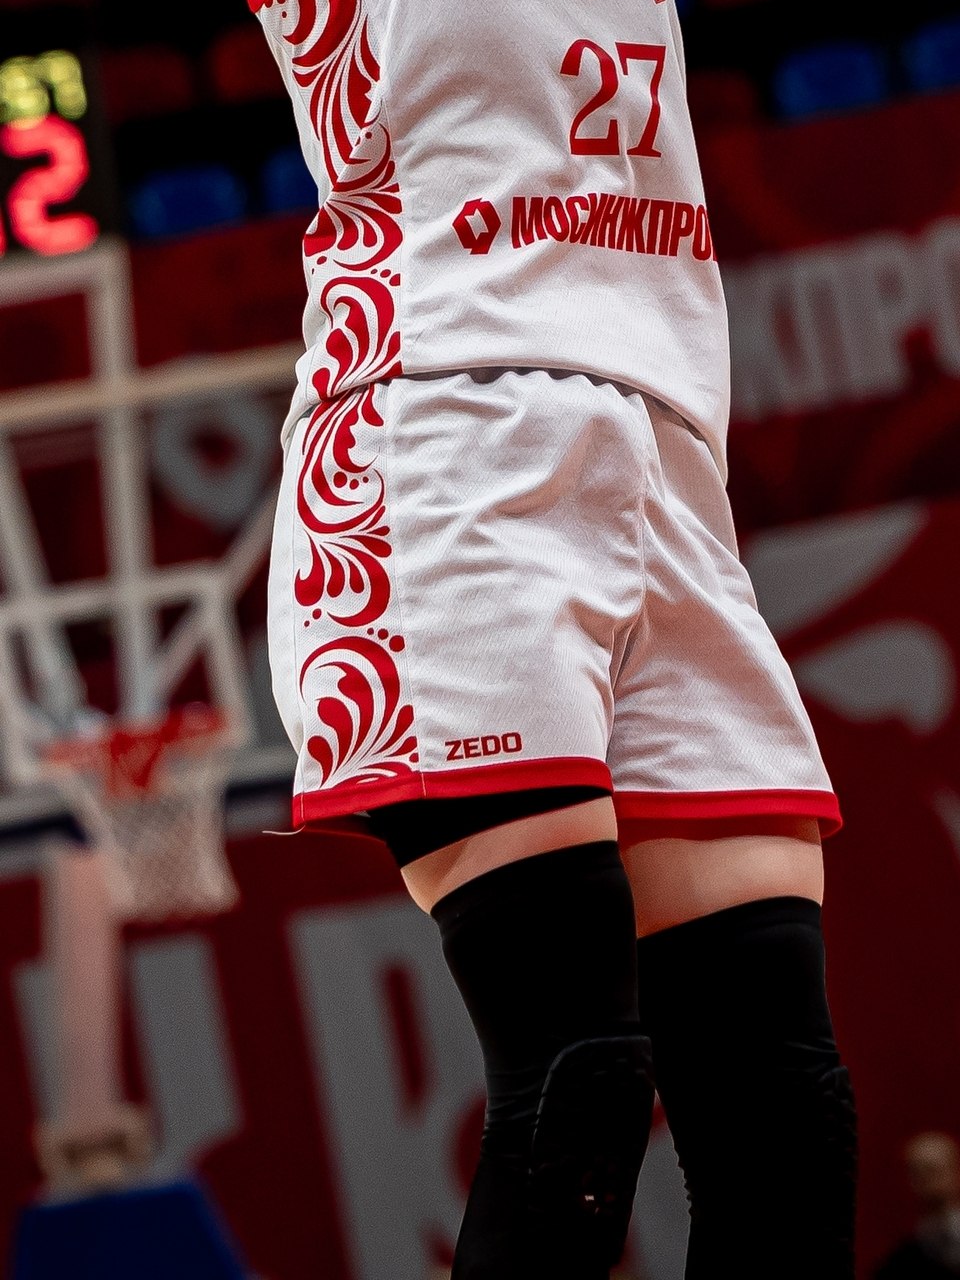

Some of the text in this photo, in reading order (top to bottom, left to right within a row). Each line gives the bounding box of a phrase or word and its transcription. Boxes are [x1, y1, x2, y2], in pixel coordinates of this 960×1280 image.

[560, 38, 667, 158] 27
[0, 114, 98, 257] 2
[511, 193, 718, 261] МОСИНЖПРО
[444, 732, 523, 761] ZEDO
